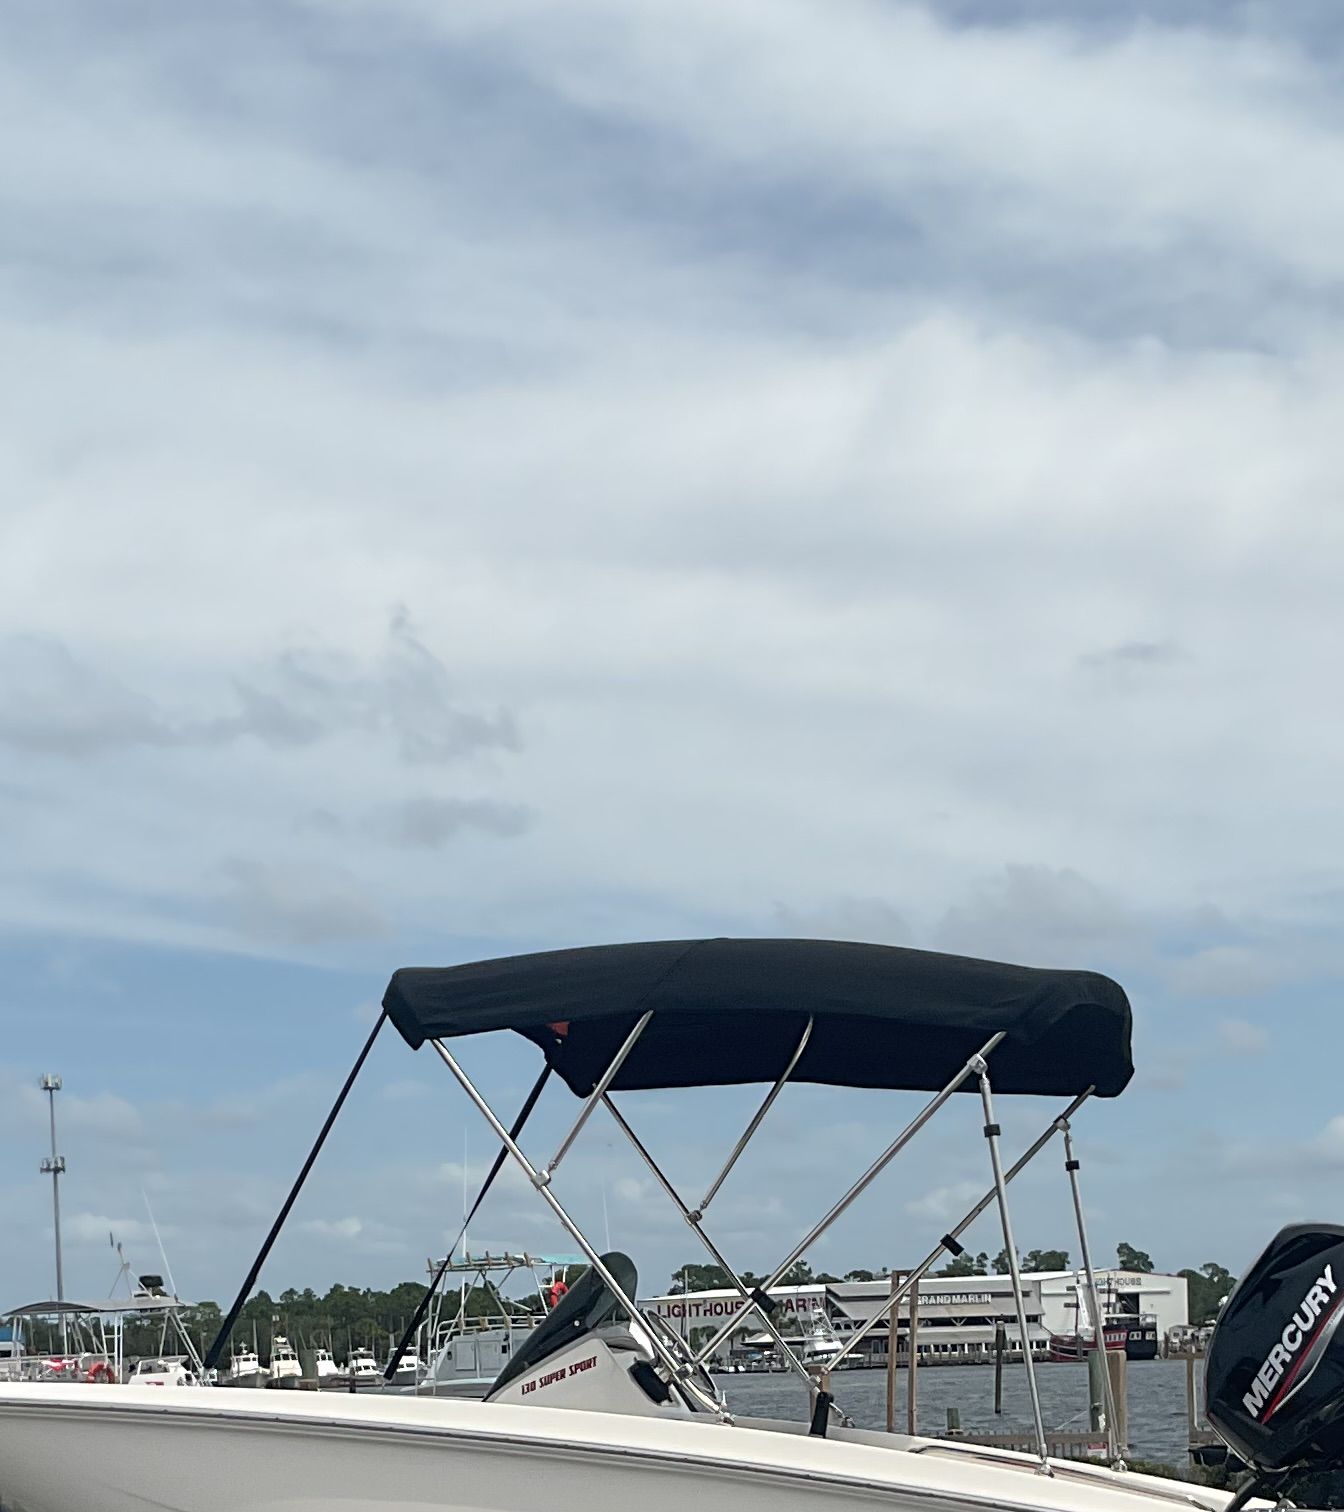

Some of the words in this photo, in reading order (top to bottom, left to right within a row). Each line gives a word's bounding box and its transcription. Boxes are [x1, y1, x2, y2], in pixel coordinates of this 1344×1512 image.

[657, 1301, 751, 1319] LIGHTHOUS
[952, 1294, 992, 1304] MARLIN
[1242, 1263, 1338, 1419] MERCURY
[521, 1380, 536, 1395] 130
[539, 1368, 566, 1388] SUPER
[569, 1356, 597, 1376] SPORT
